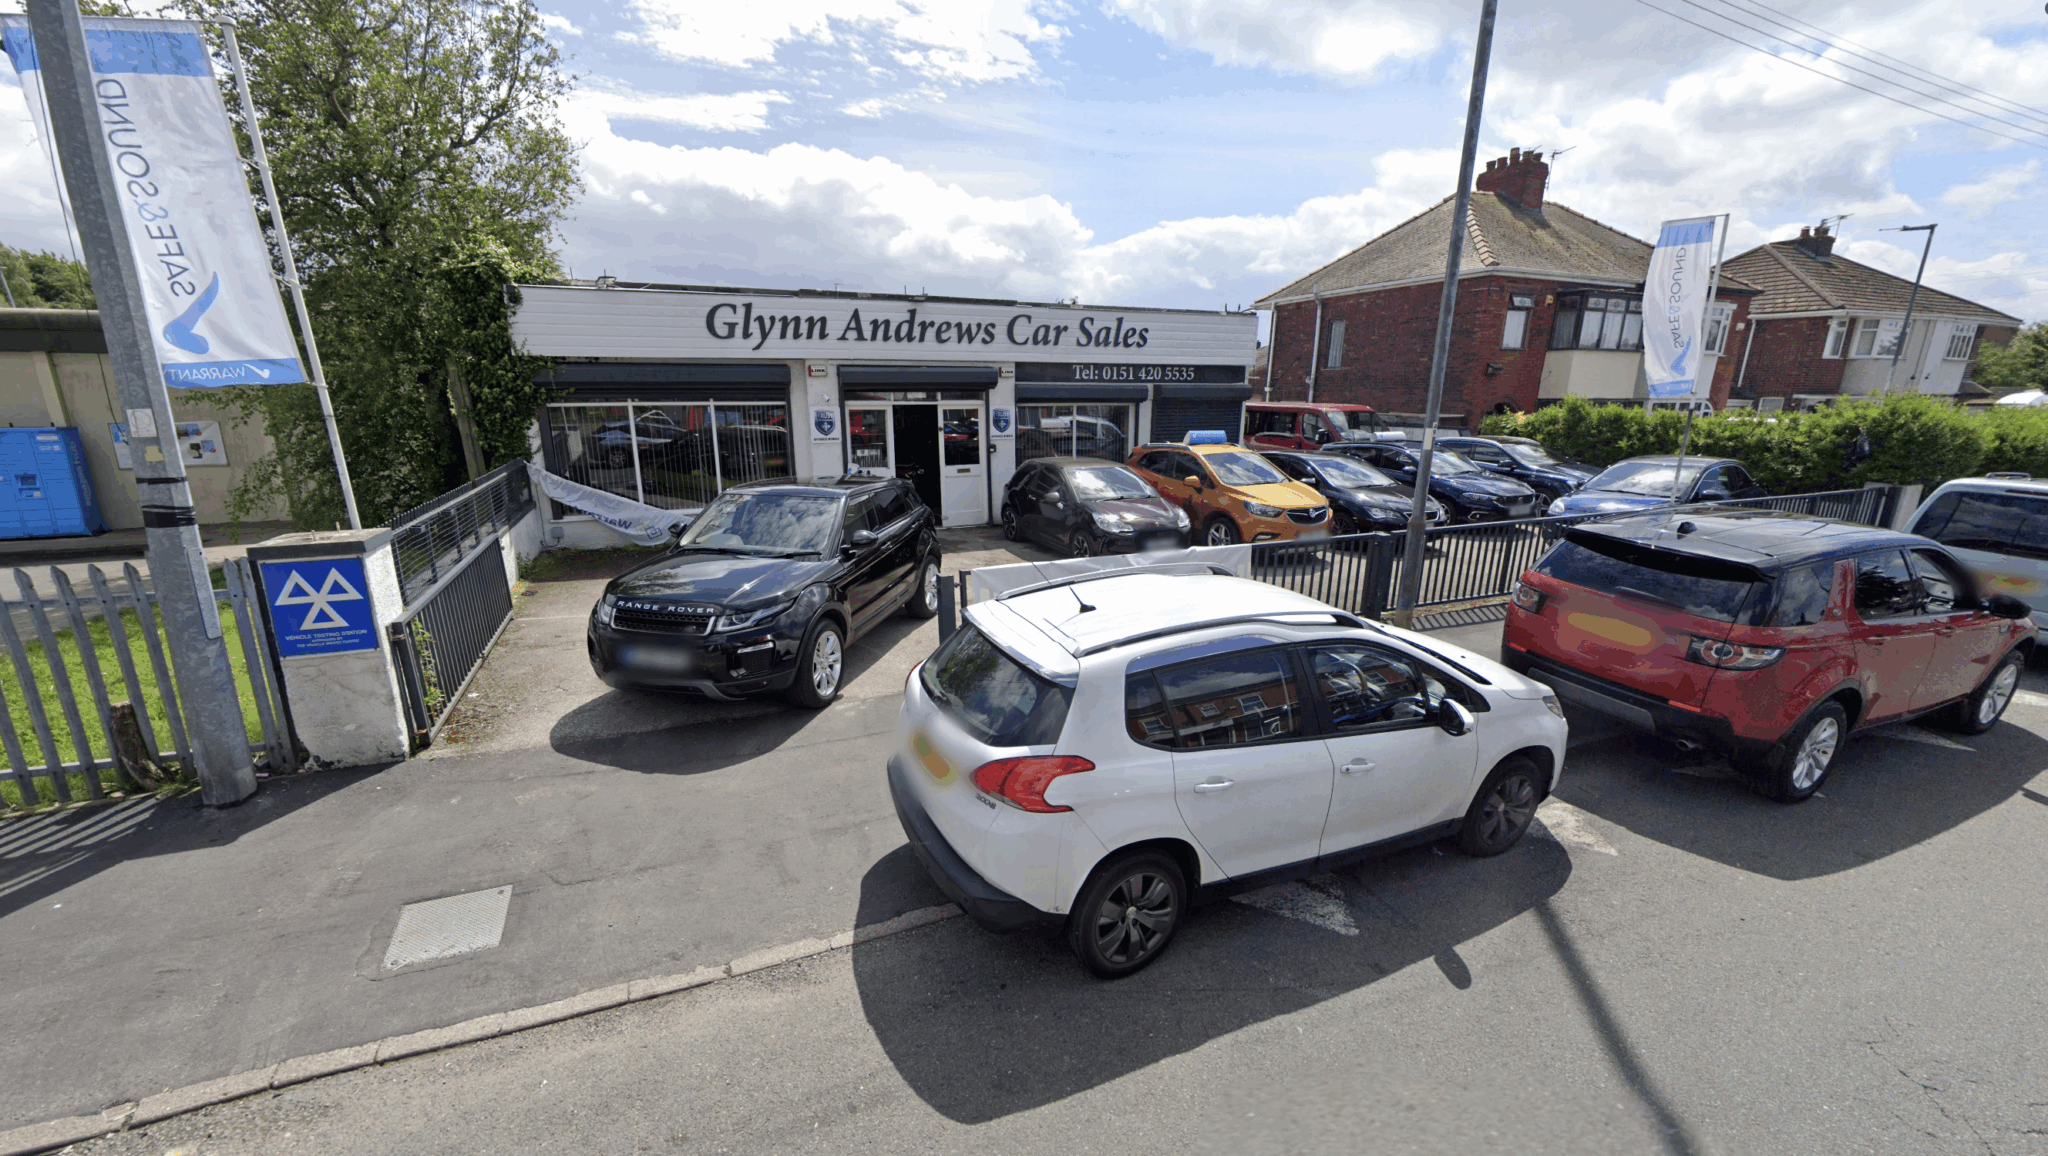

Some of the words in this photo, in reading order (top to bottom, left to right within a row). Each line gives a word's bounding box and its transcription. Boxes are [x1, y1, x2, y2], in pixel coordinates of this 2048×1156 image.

[705, 302, 830, 351] Glynn
[836, 307, 997, 346] Andrews
[1006, 313, 1069, 346] Car
[1076, 316, 1150, 349] Sales
[1072, 364, 1099, 380] Tel:
[1102, 366, 1135, 380] 0151
[1138, 366, 1162, 380] 420
[1164, 366, 1195, 380] 5535
[617, 600, 660, 611] RANGE
[667, 605, 715, 614] ROVER
